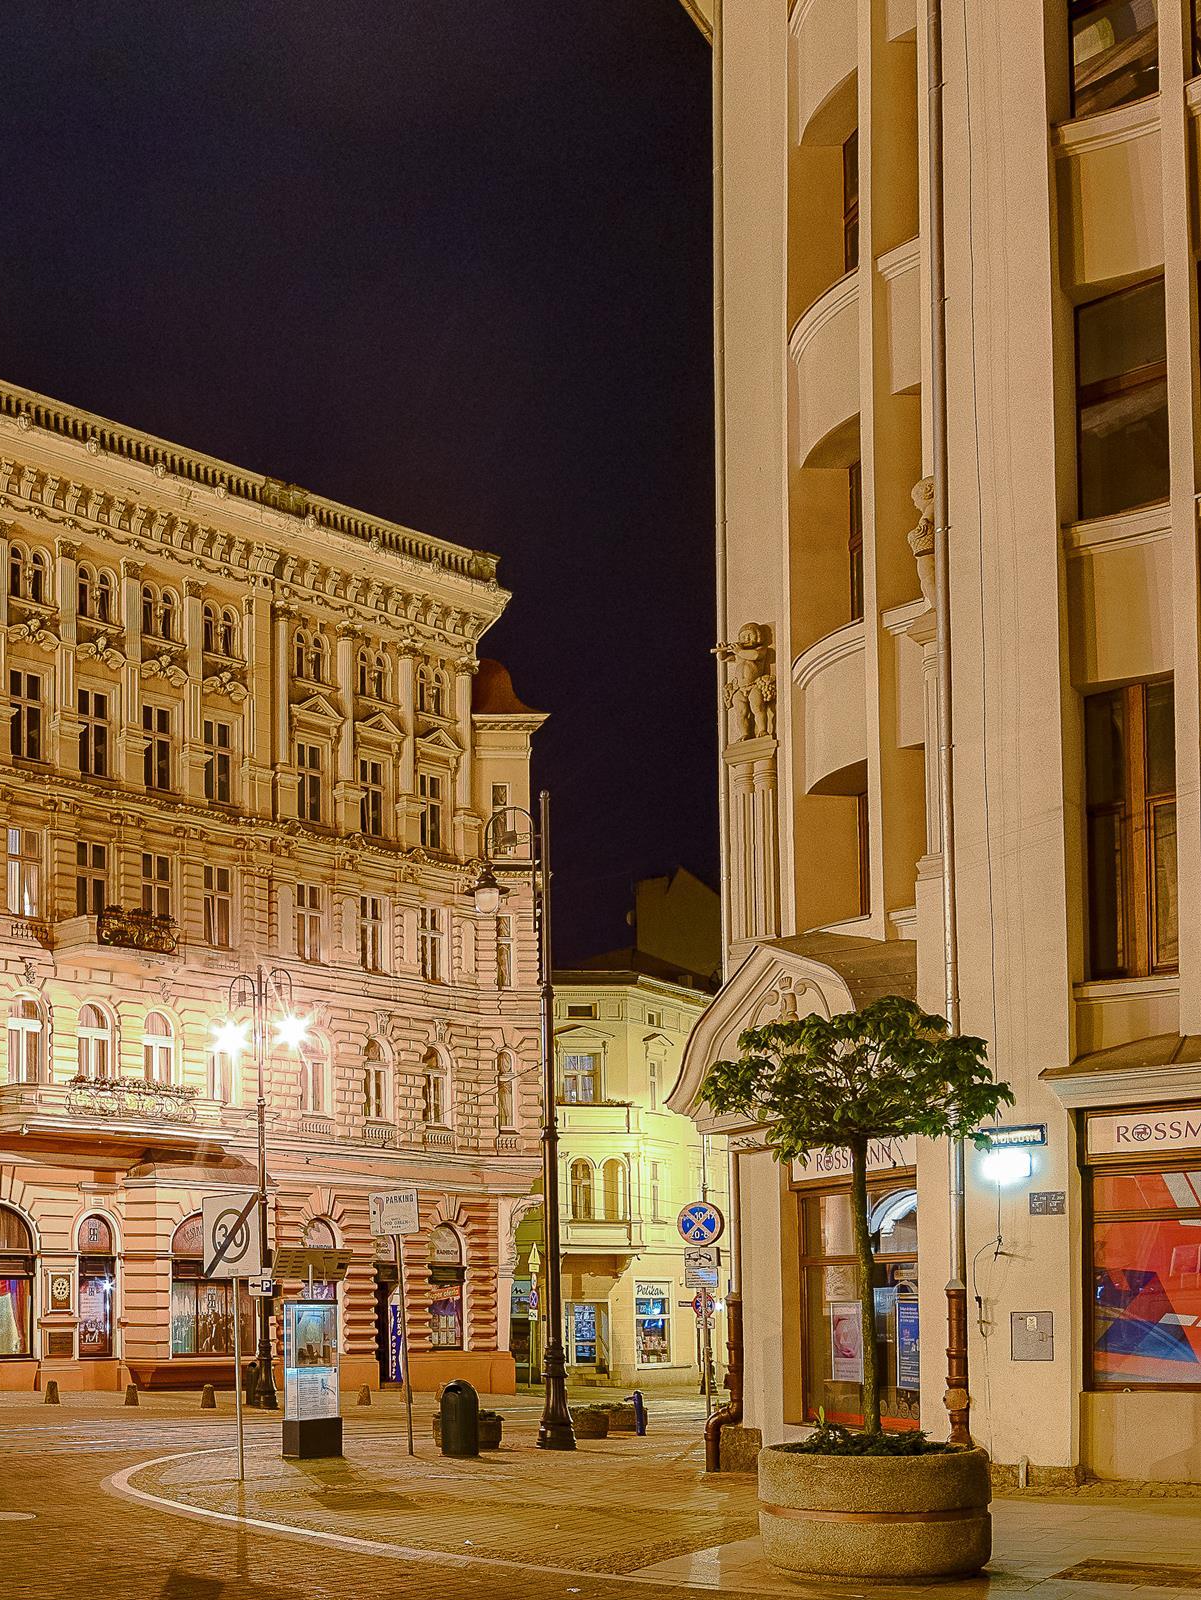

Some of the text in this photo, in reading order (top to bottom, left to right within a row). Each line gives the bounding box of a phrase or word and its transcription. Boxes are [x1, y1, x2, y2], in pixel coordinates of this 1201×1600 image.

[386, 1194, 414, 1204] PARKING
[262, 1281, 270, 1291] P
[636, 1284, 665, 1296] Pelikan
